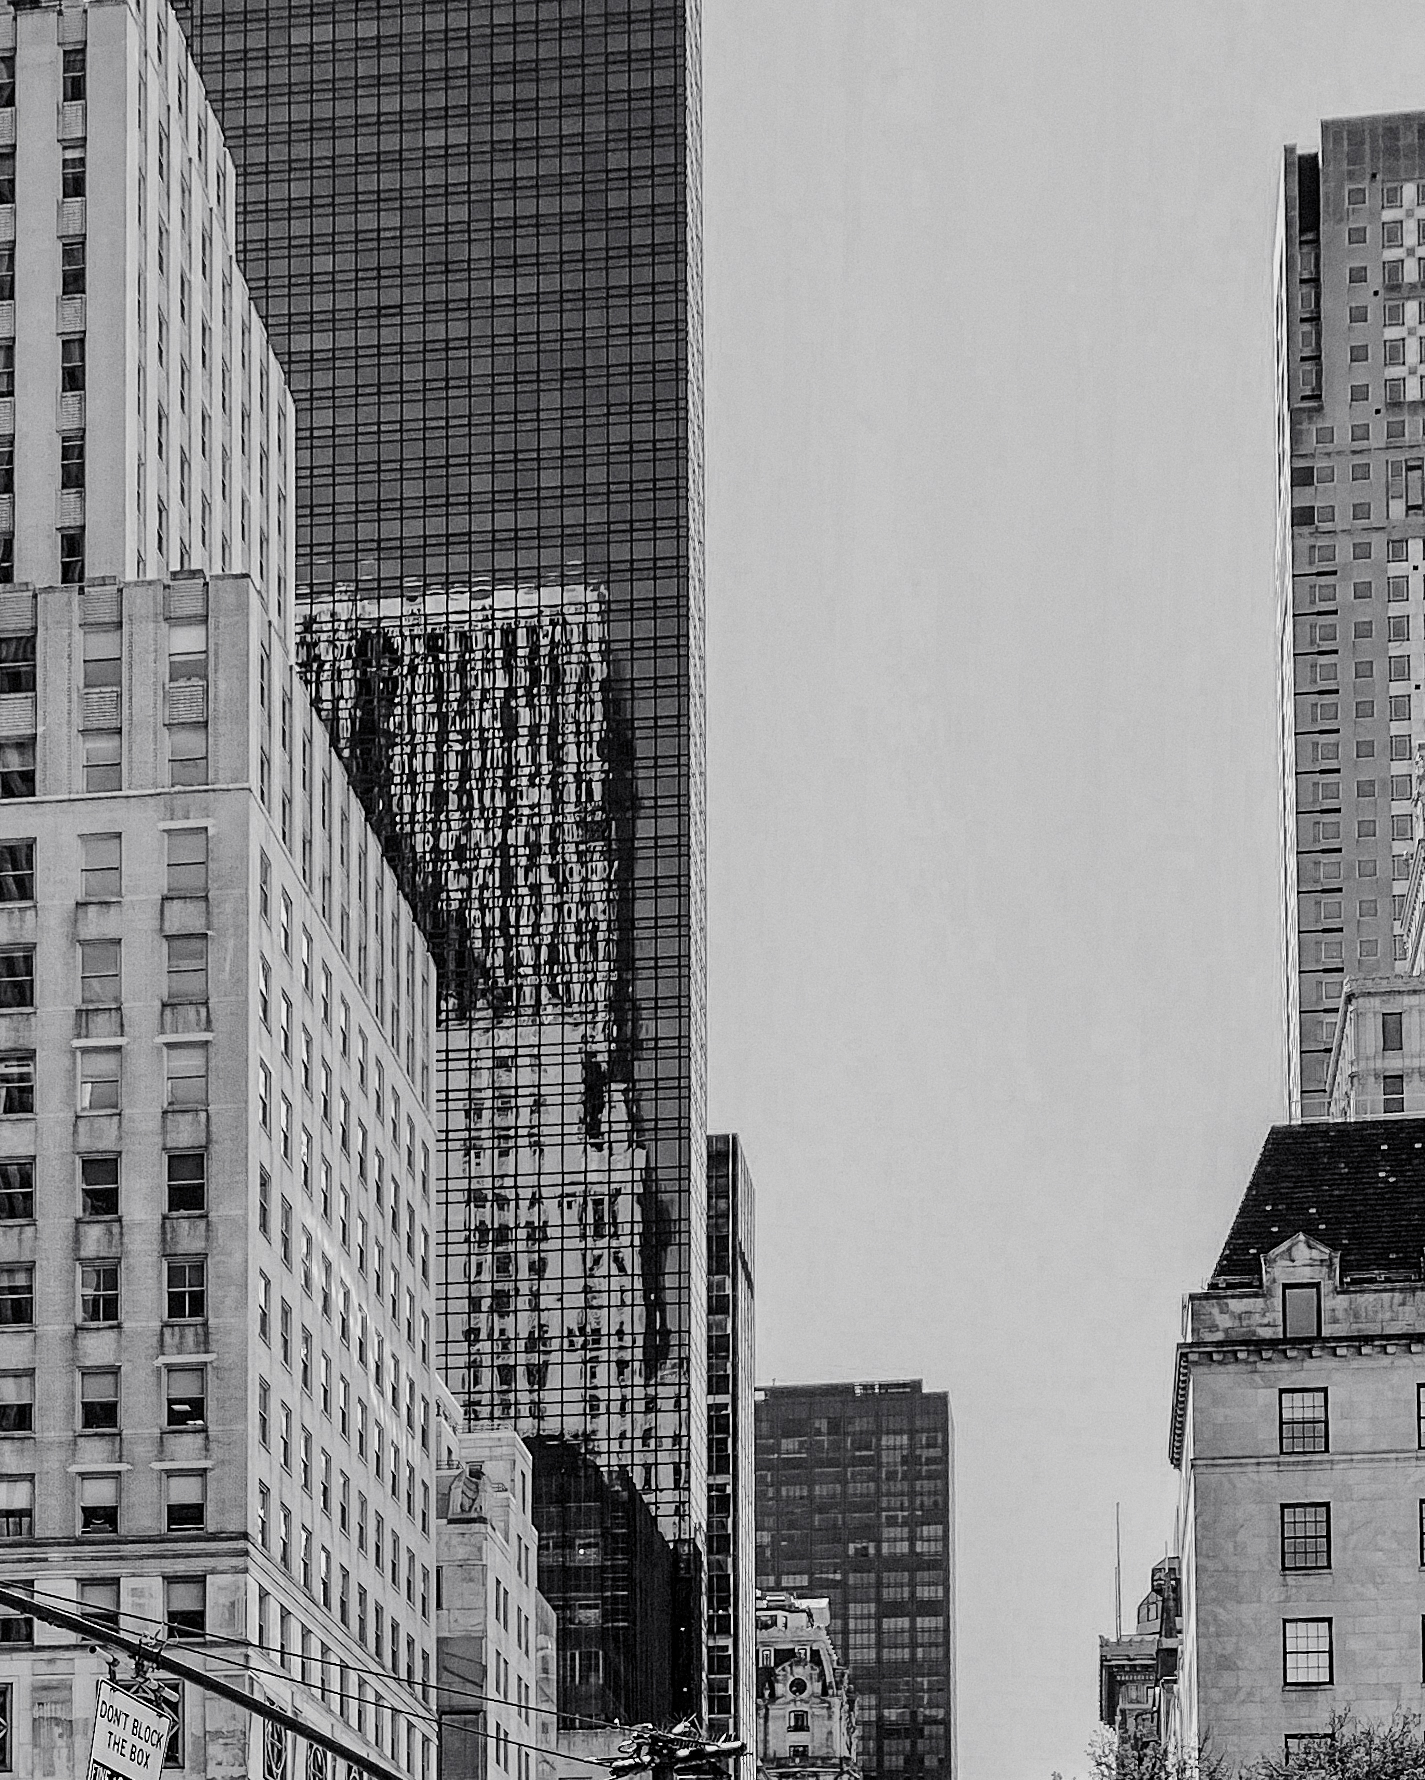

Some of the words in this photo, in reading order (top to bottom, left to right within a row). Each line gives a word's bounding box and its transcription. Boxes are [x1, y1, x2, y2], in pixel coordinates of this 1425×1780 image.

[107, 1730, 128, 1757] THE
[129, 1743, 151, 1769] BOX
[131, 1718, 164, 1750] BLOCK
